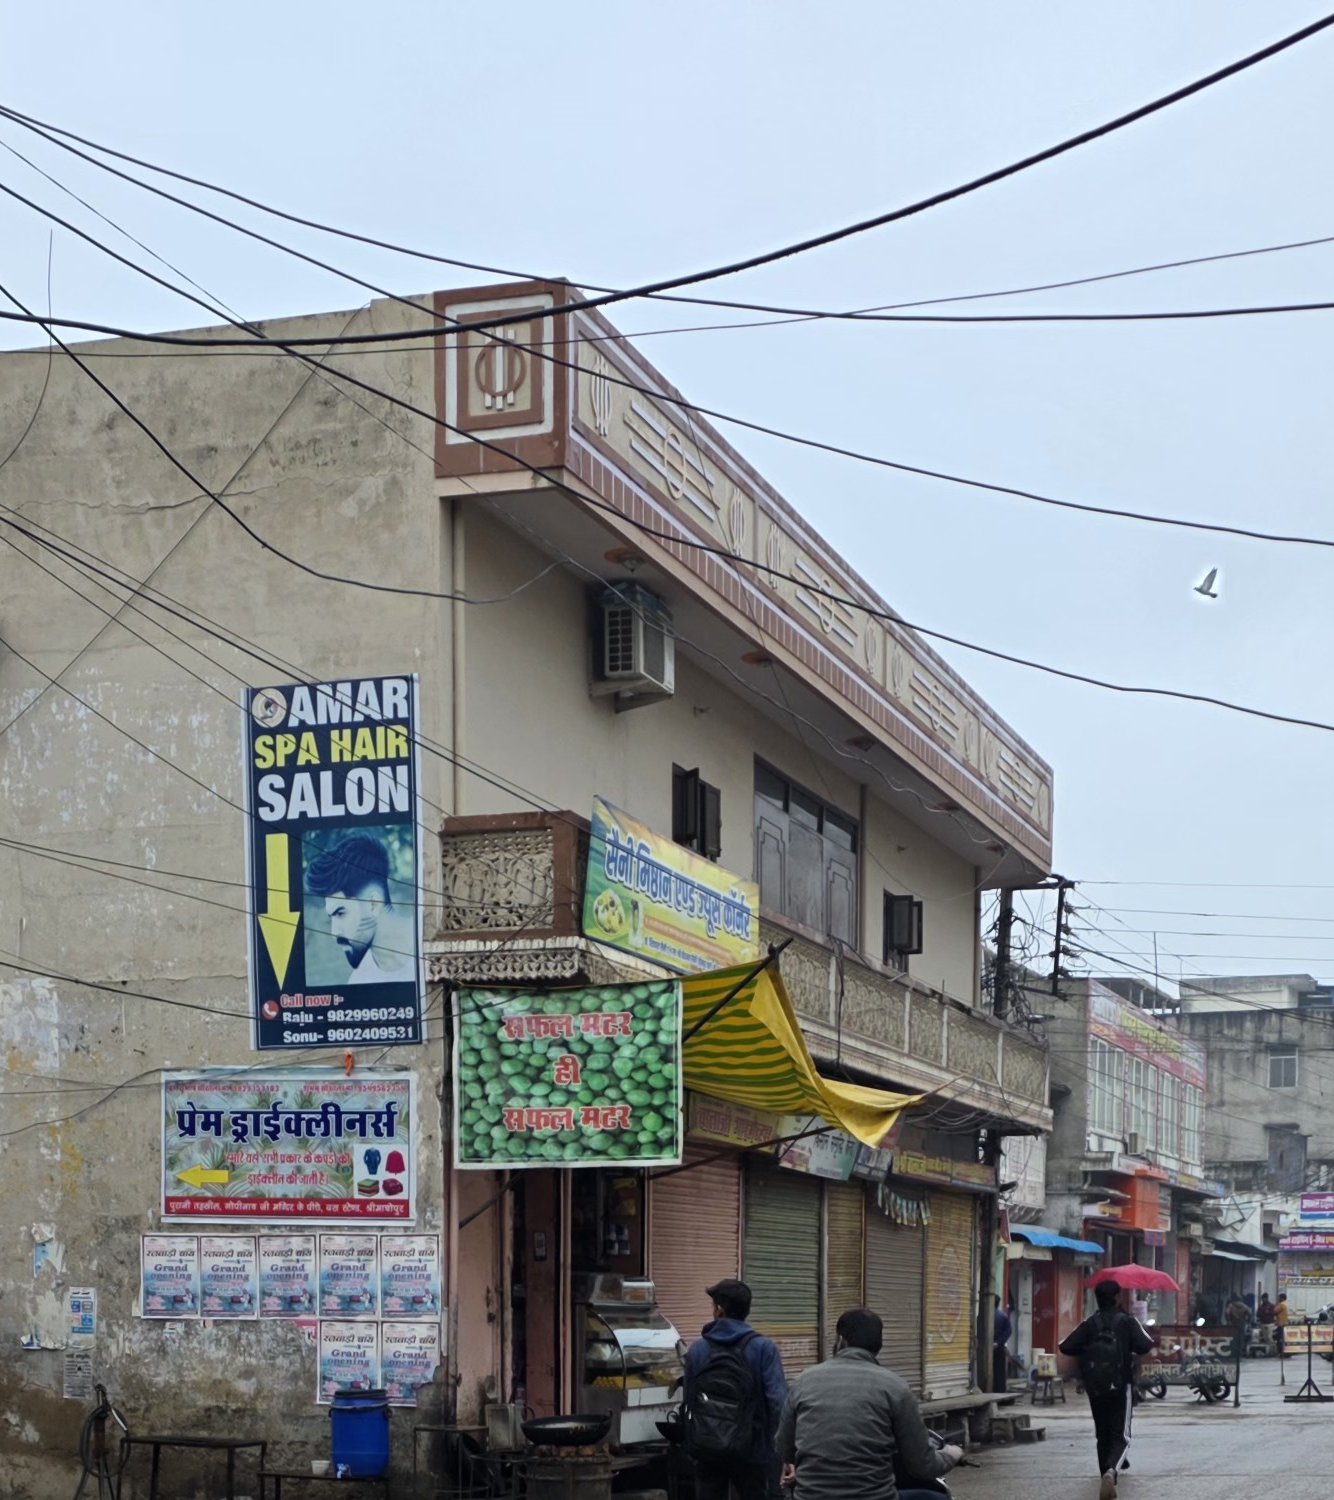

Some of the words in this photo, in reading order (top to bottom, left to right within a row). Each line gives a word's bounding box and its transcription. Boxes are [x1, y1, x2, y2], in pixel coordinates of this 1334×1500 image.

[287, 678, 410, 728] AMAR
[254, 730, 321, 769] SPA
[330, 725, 410, 763] HAIR
[257, 764, 410, 822] SALON
[605, 828, 634, 890] सैनी
[280, 994, 304, 1007] Call
[305, 995, 331, 1007] now
[282, 1010, 314, 1026] Raju
[501, 1014, 575, 1041] सफल
[579, 1012, 634, 1038] मटर
[553, 1054, 582, 1086] ही
[175, 1101, 225, 1138] प्रेम
[229, 1101, 398, 1144] ड्राईक्लीनर्स
[502, 1106, 575, 1133] सफल
[579, 1105, 633, 1131] मटर
[154, 1263, 188, 1273] Grand
[211, 1264, 246, 1274] Grand
[270, 1264, 306, 1273] Grand
[331, 1263, 366, 1272] Grand
[392, 1264, 428, 1272] Grand
[331, 1349, 366, 1358] Grand
[393, 1350, 427, 1359] Grand
